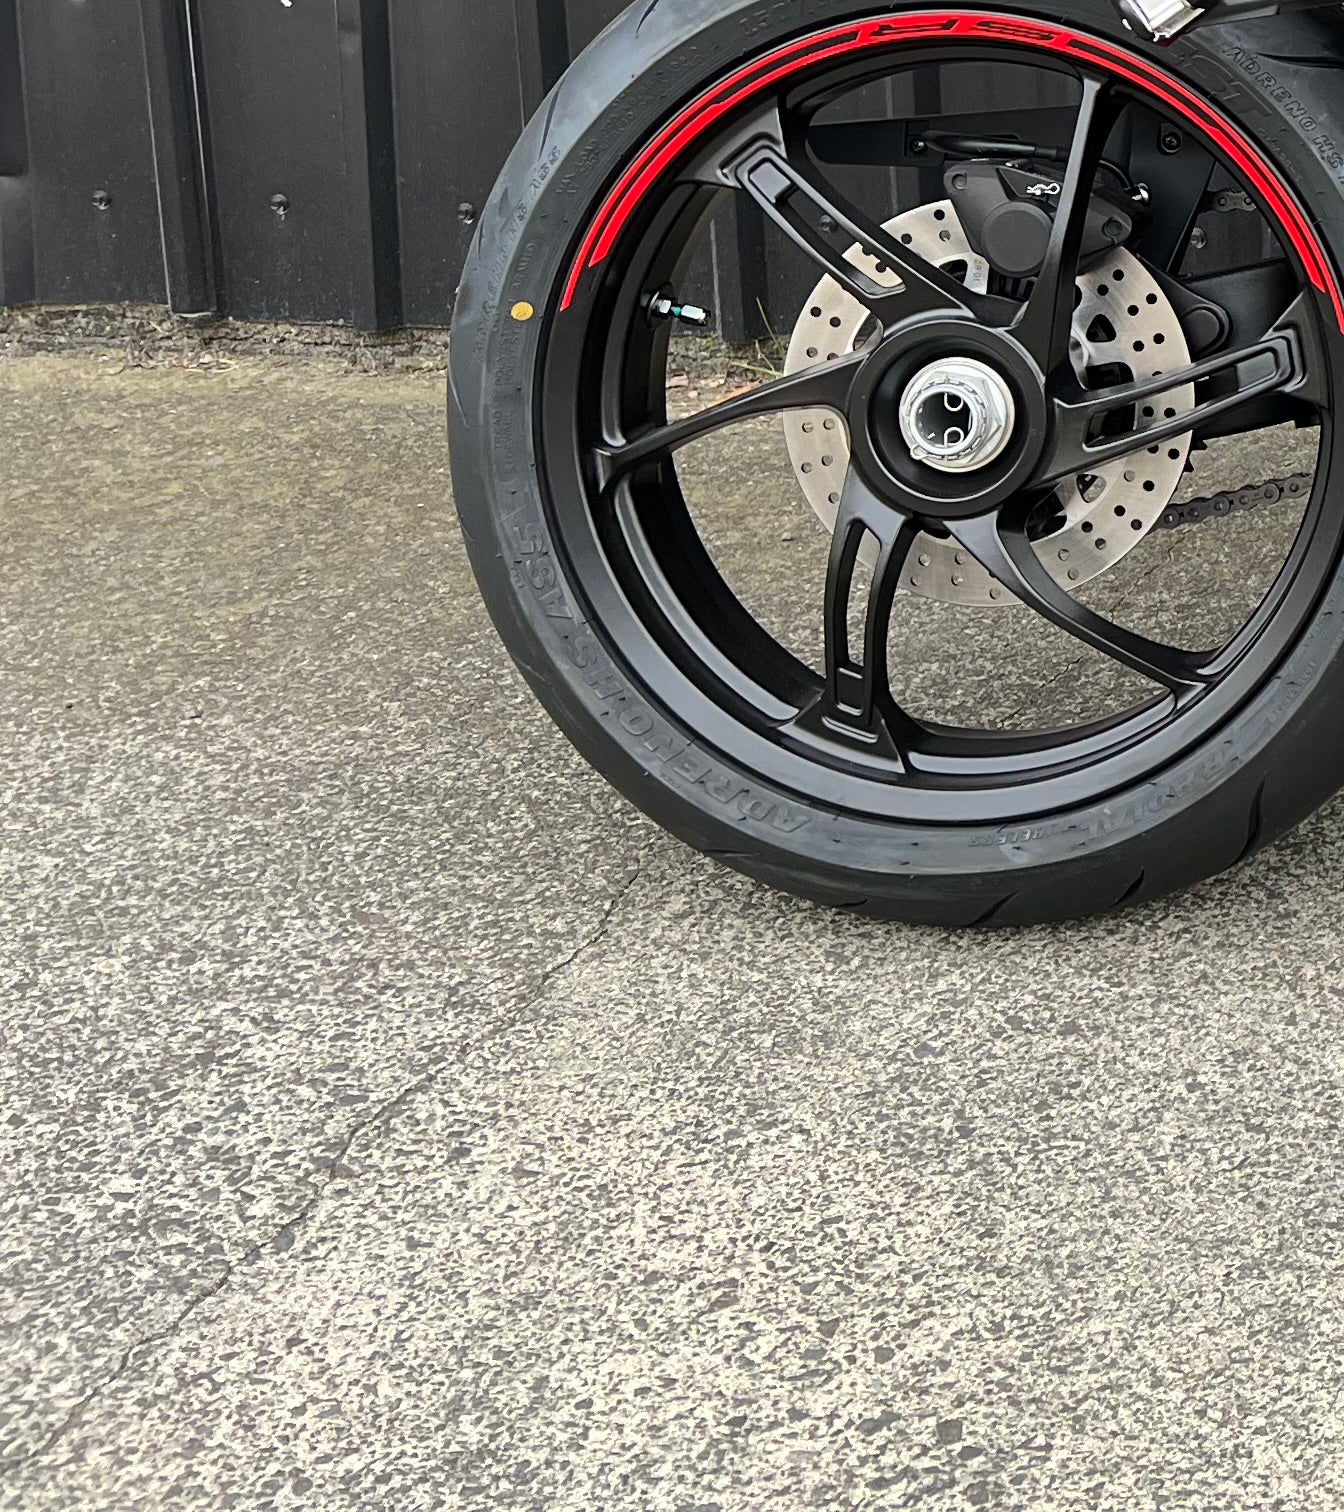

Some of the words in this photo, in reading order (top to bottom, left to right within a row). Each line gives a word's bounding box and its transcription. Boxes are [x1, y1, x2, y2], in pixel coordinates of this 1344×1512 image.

[1221, 37, 1321, 136] ADRENO
[558, 632, 626, 709] HS
[613, 699, 815, 841] ADRENO
